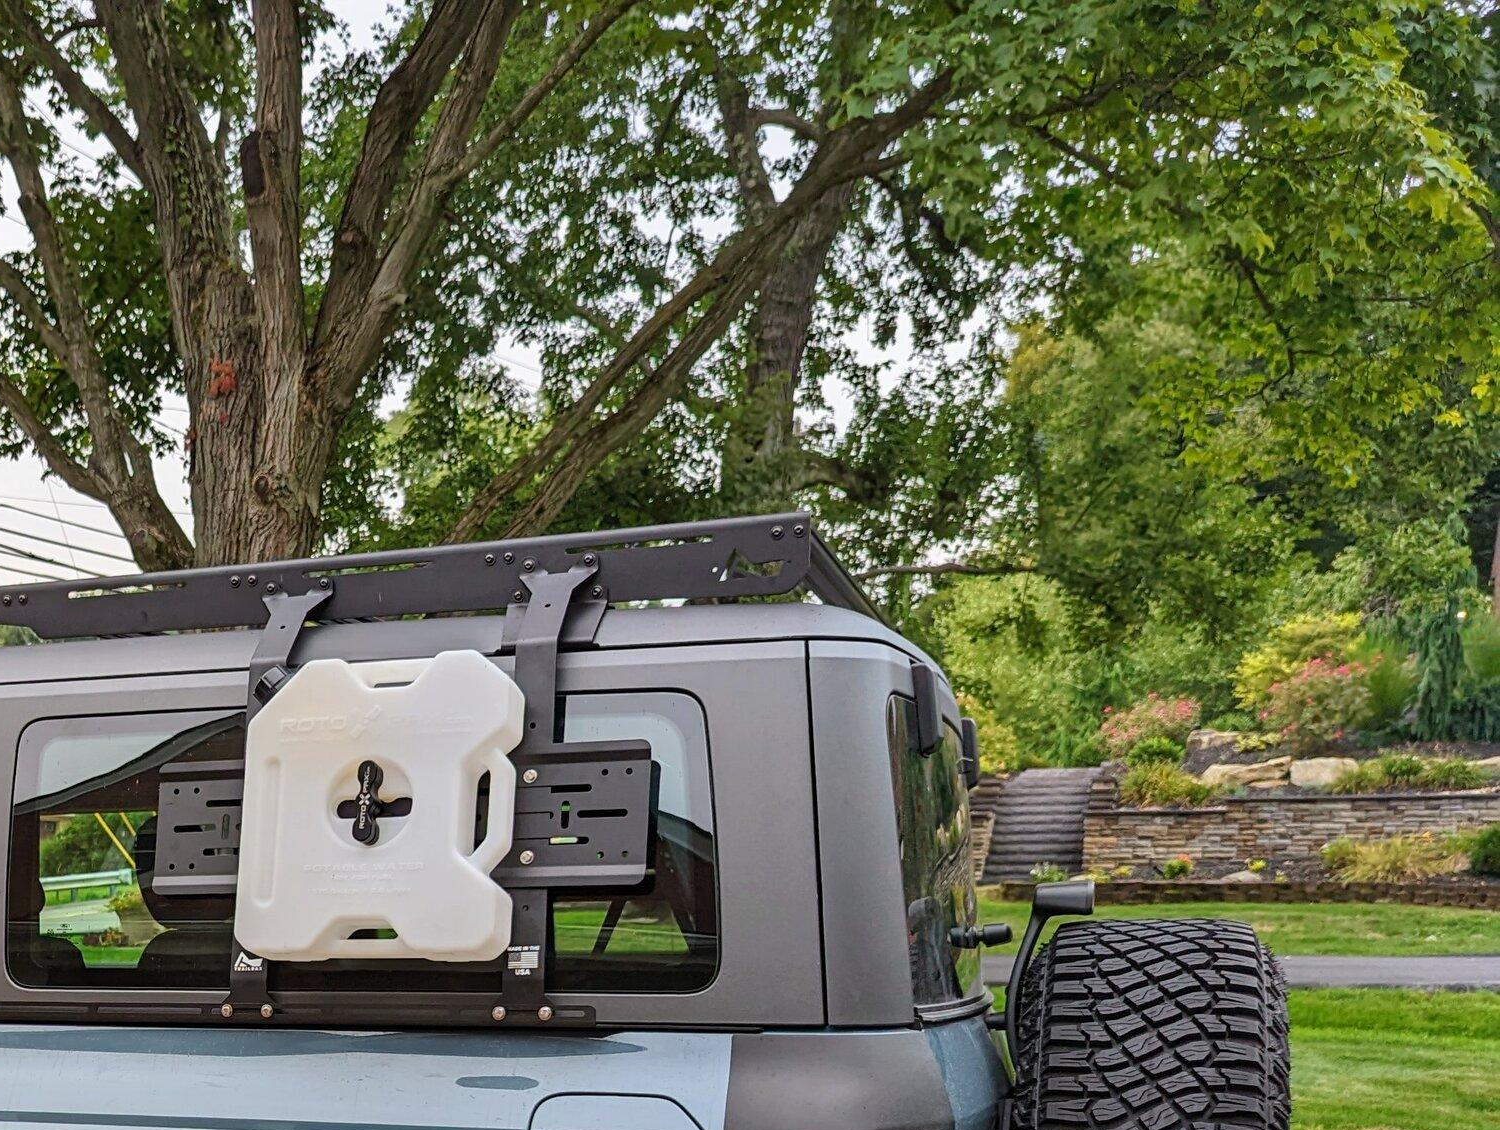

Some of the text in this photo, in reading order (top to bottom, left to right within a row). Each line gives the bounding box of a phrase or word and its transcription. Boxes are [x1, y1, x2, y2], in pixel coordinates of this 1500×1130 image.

[279, 717, 348, 733] ROTO
[372, 861, 425, 872] WATER
[514, 968, 531, 976] USA
